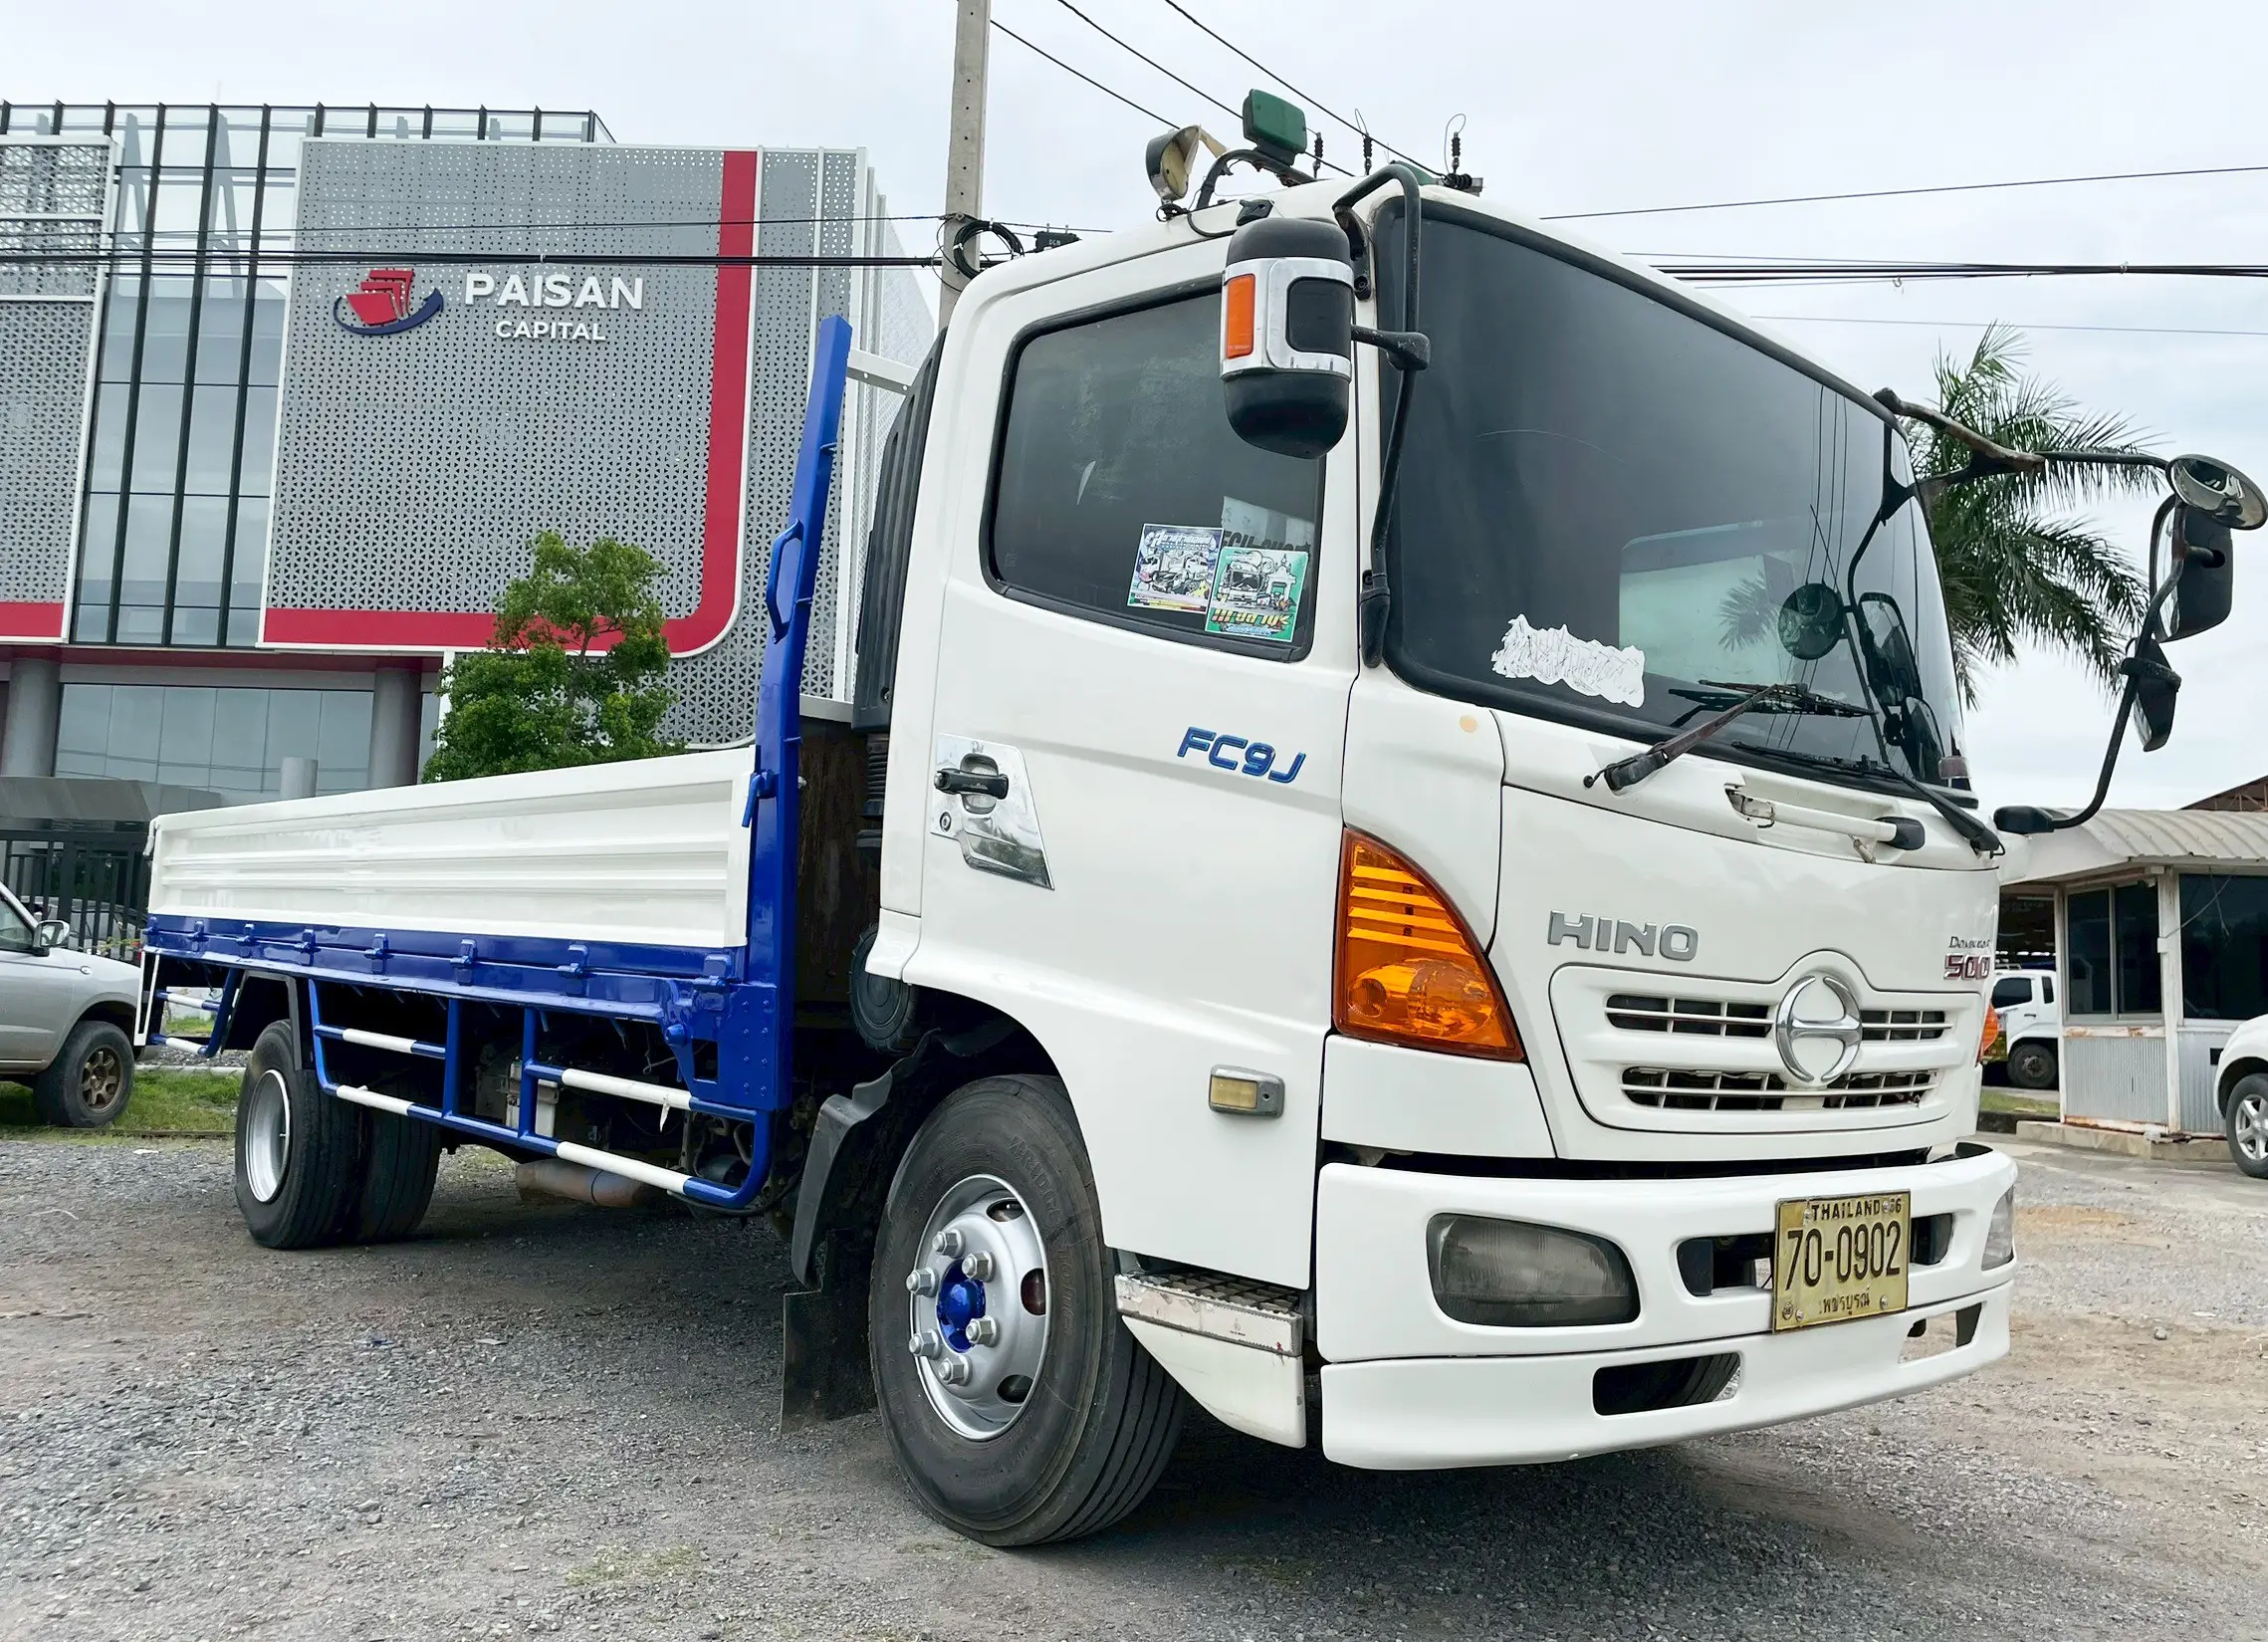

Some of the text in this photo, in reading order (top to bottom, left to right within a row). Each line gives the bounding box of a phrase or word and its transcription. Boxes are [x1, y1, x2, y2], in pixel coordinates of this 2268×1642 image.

[465, 272, 643, 311] PAISAN
[495, 320, 606, 343] CAPITAL
[1176, 726, 1307, 784] FC9J
[1547, 909, 1699, 962] HINO
[1942, 952, 1991, 981] 500
[1811, 1198, 1881, 1222] THAILAND
[1784, 1220, 1902, 1291] 70-0902
